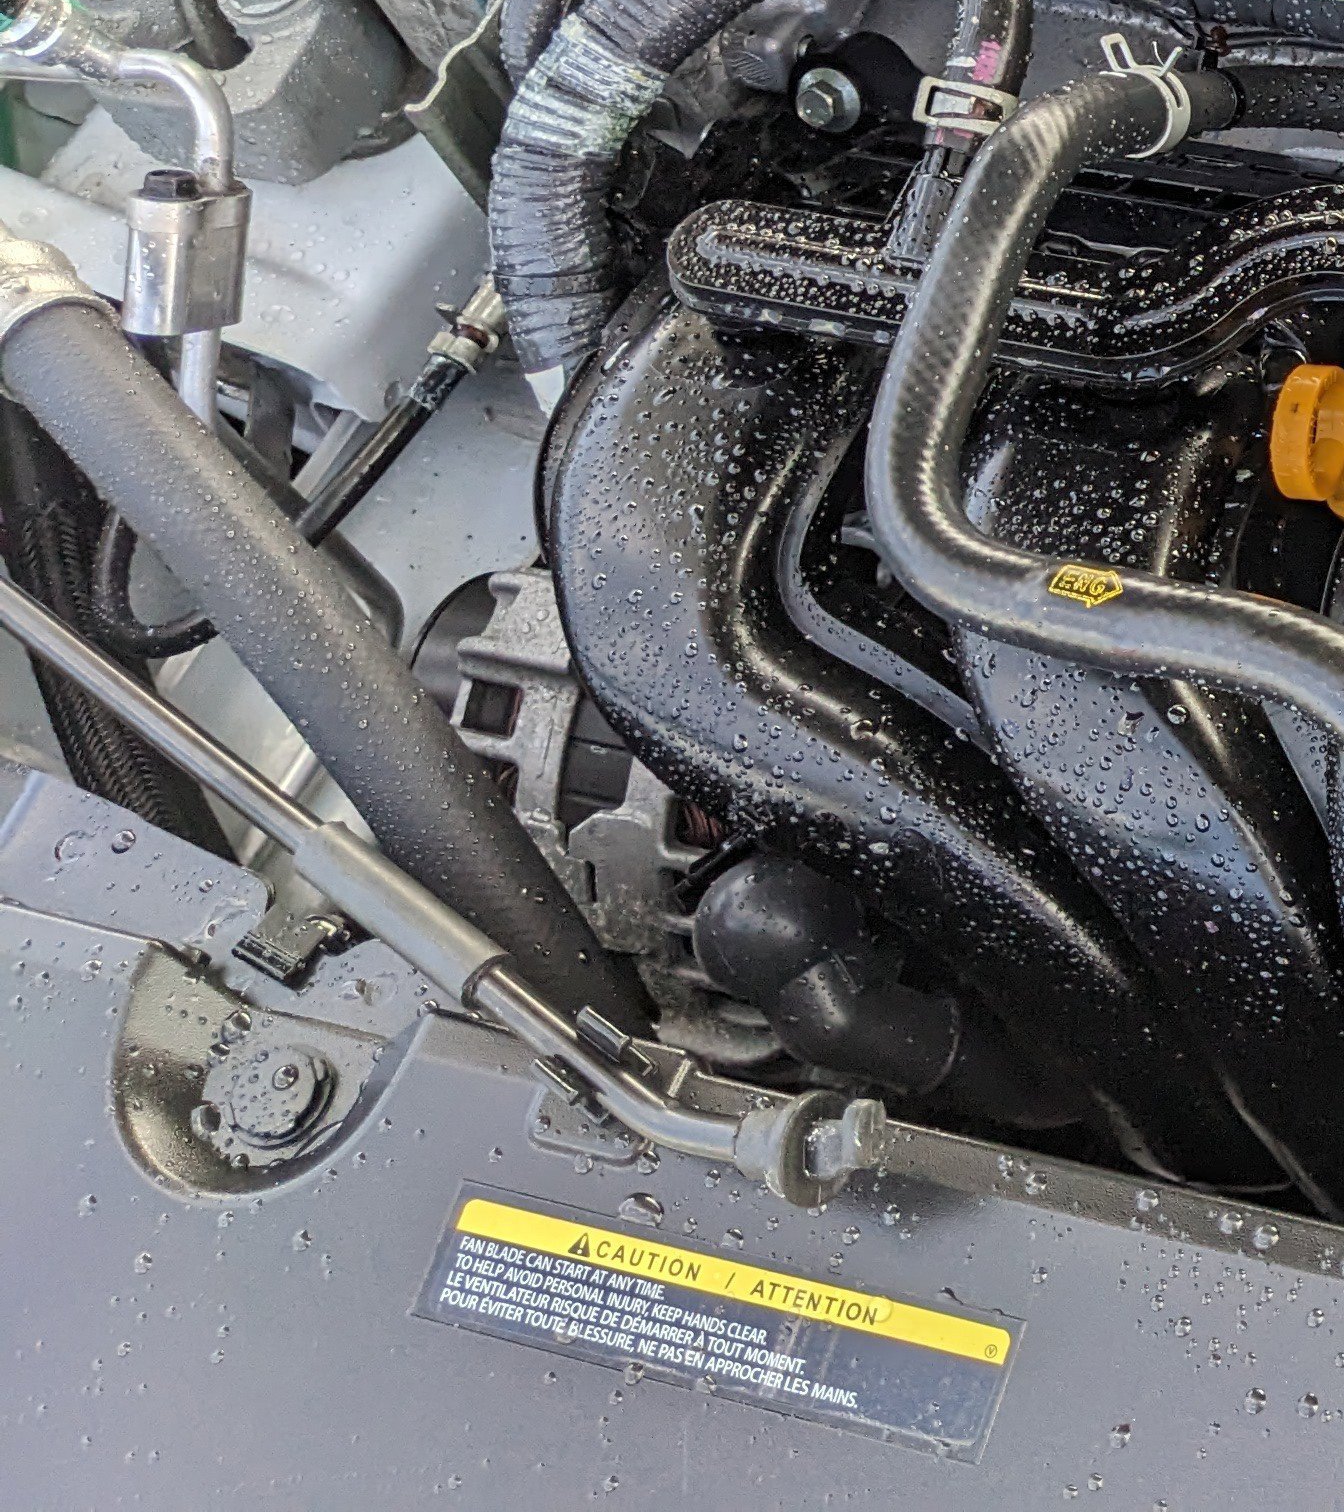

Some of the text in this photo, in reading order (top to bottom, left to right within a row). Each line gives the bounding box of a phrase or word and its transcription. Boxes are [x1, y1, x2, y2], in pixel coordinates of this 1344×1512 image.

[1058, 570, 1107, 595] ENG
[456, 1253, 768, 1346] TO HELP AVOID PERSONAL INJURY, KEEP HANDS CLEAR.
[459, 1236, 666, 1301] FAN BLADE CAN START AT ANY TIME.
[596, 1241, 702, 1281] CAUTION
[750, 1280, 878, 1326] ATTENTION
[439, 1288, 859, 1409] POUR ÉVITER TOUTE BLESSURE, NE PAS EN APPROCHER LES MAINS.
[446, 1271, 463, 1287] LE
[464, 1275, 549, 1310] VENTILATEUR
[549, 1297, 600, 1324] RISQUE
[600, 1310, 619, 1327] DE
[619, 1315, 698, 1346] DÉMARRER
[707, 1336, 745, 1357] TOUT
[744, 1346, 807, 1375] MOMENT.
